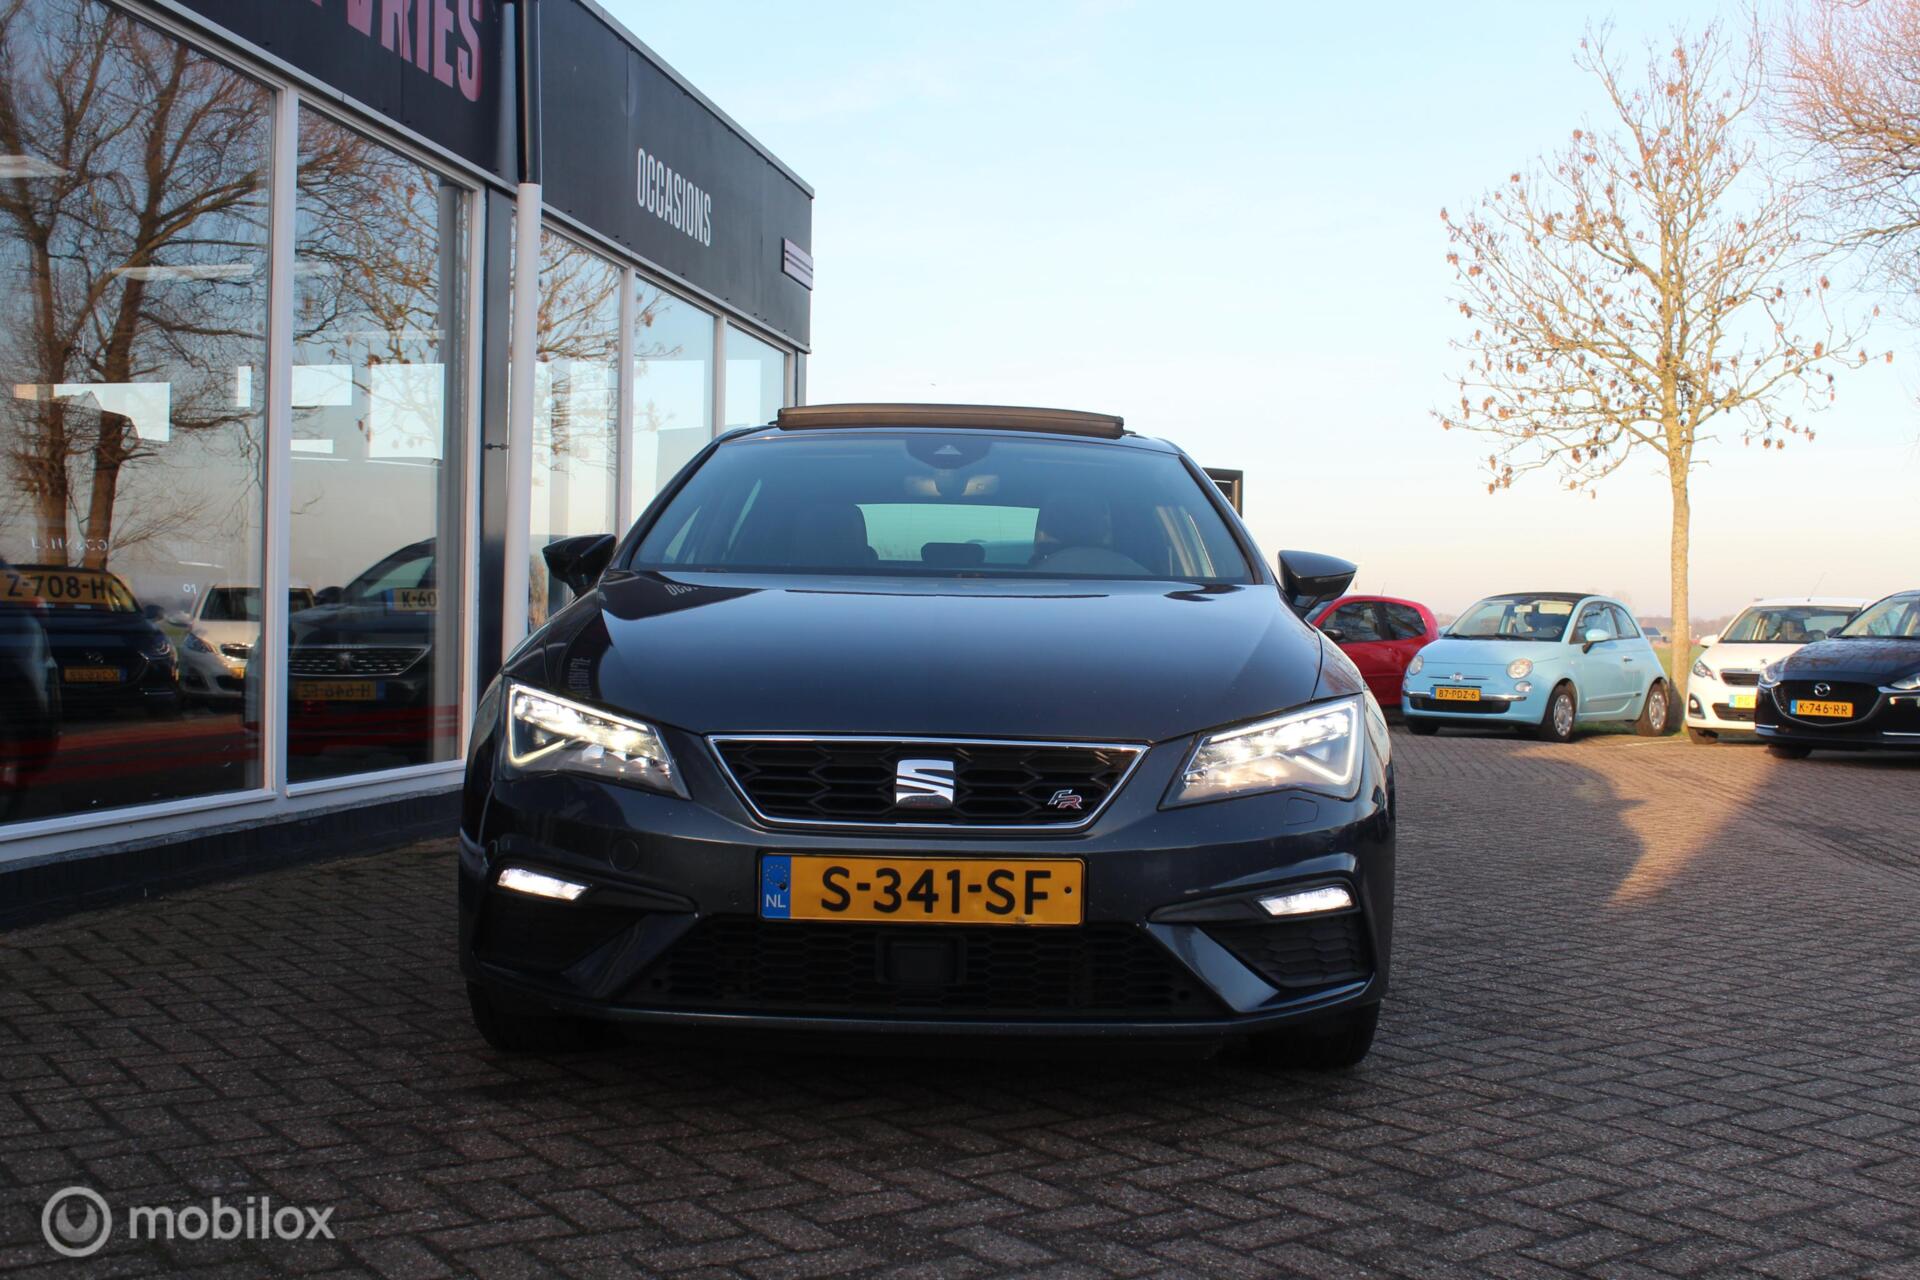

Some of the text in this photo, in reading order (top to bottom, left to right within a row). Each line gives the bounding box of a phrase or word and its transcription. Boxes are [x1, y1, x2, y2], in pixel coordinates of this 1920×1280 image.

[637, 148, 711, 247] OCCASIONS
[1798, 703, 1848, 715] K-746-RR
[765, 893, 787, 909] NL
[820, 865, 1052, 916] S-341-SF
